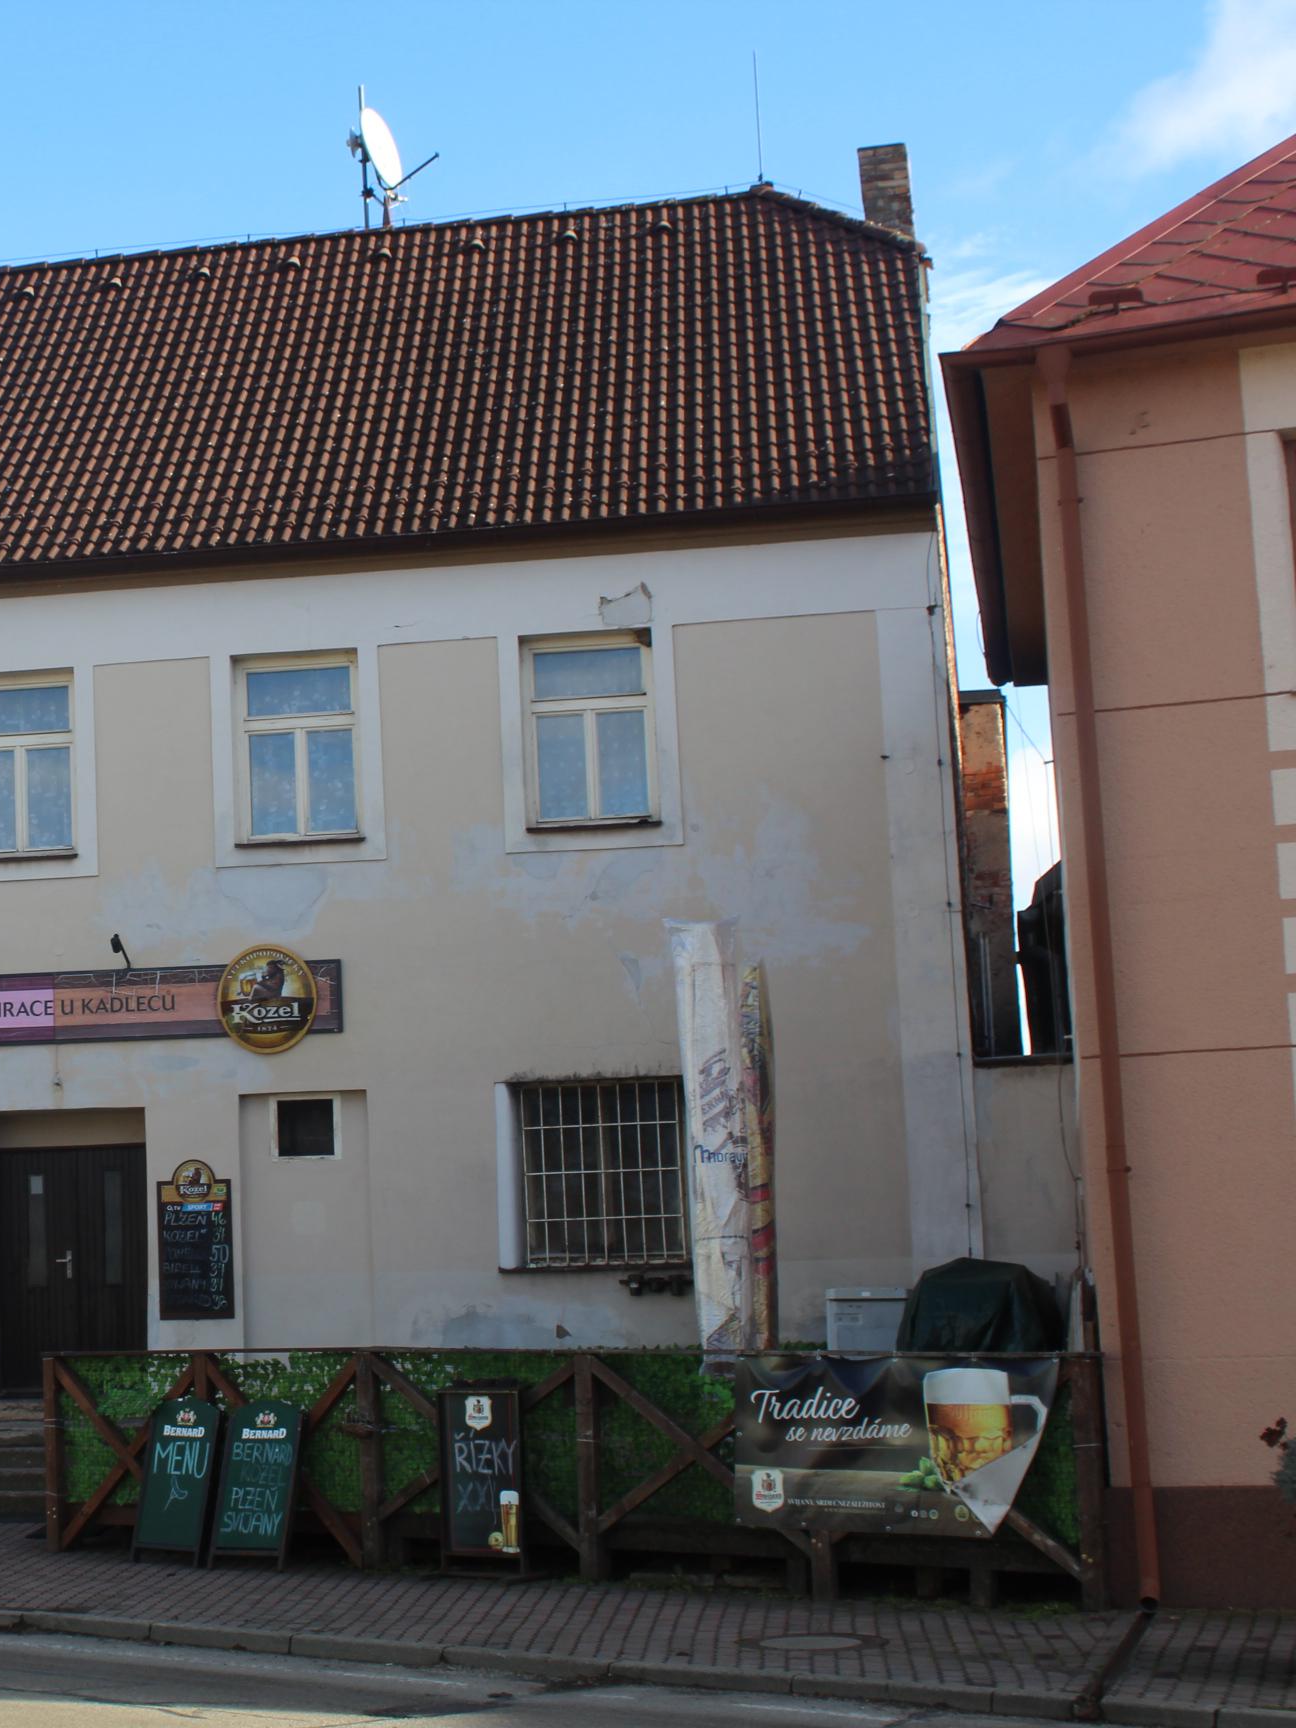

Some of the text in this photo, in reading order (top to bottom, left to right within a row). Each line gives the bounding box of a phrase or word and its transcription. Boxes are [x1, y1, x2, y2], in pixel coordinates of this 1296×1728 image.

[60, 999, 74, 1015] U
[231, 1001, 301, 1024] Kozel
[750, 1387, 860, 1424] Tradice
[163, 1424, 206, 1438] BERNARD
[242, 1427, 287, 1440] BERNARD
[785, 1417, 912, 1443] se nevzdáme
[153, 1441, 210, 1479] MENU
[232, 1442, 293, 1466] BERNARD
